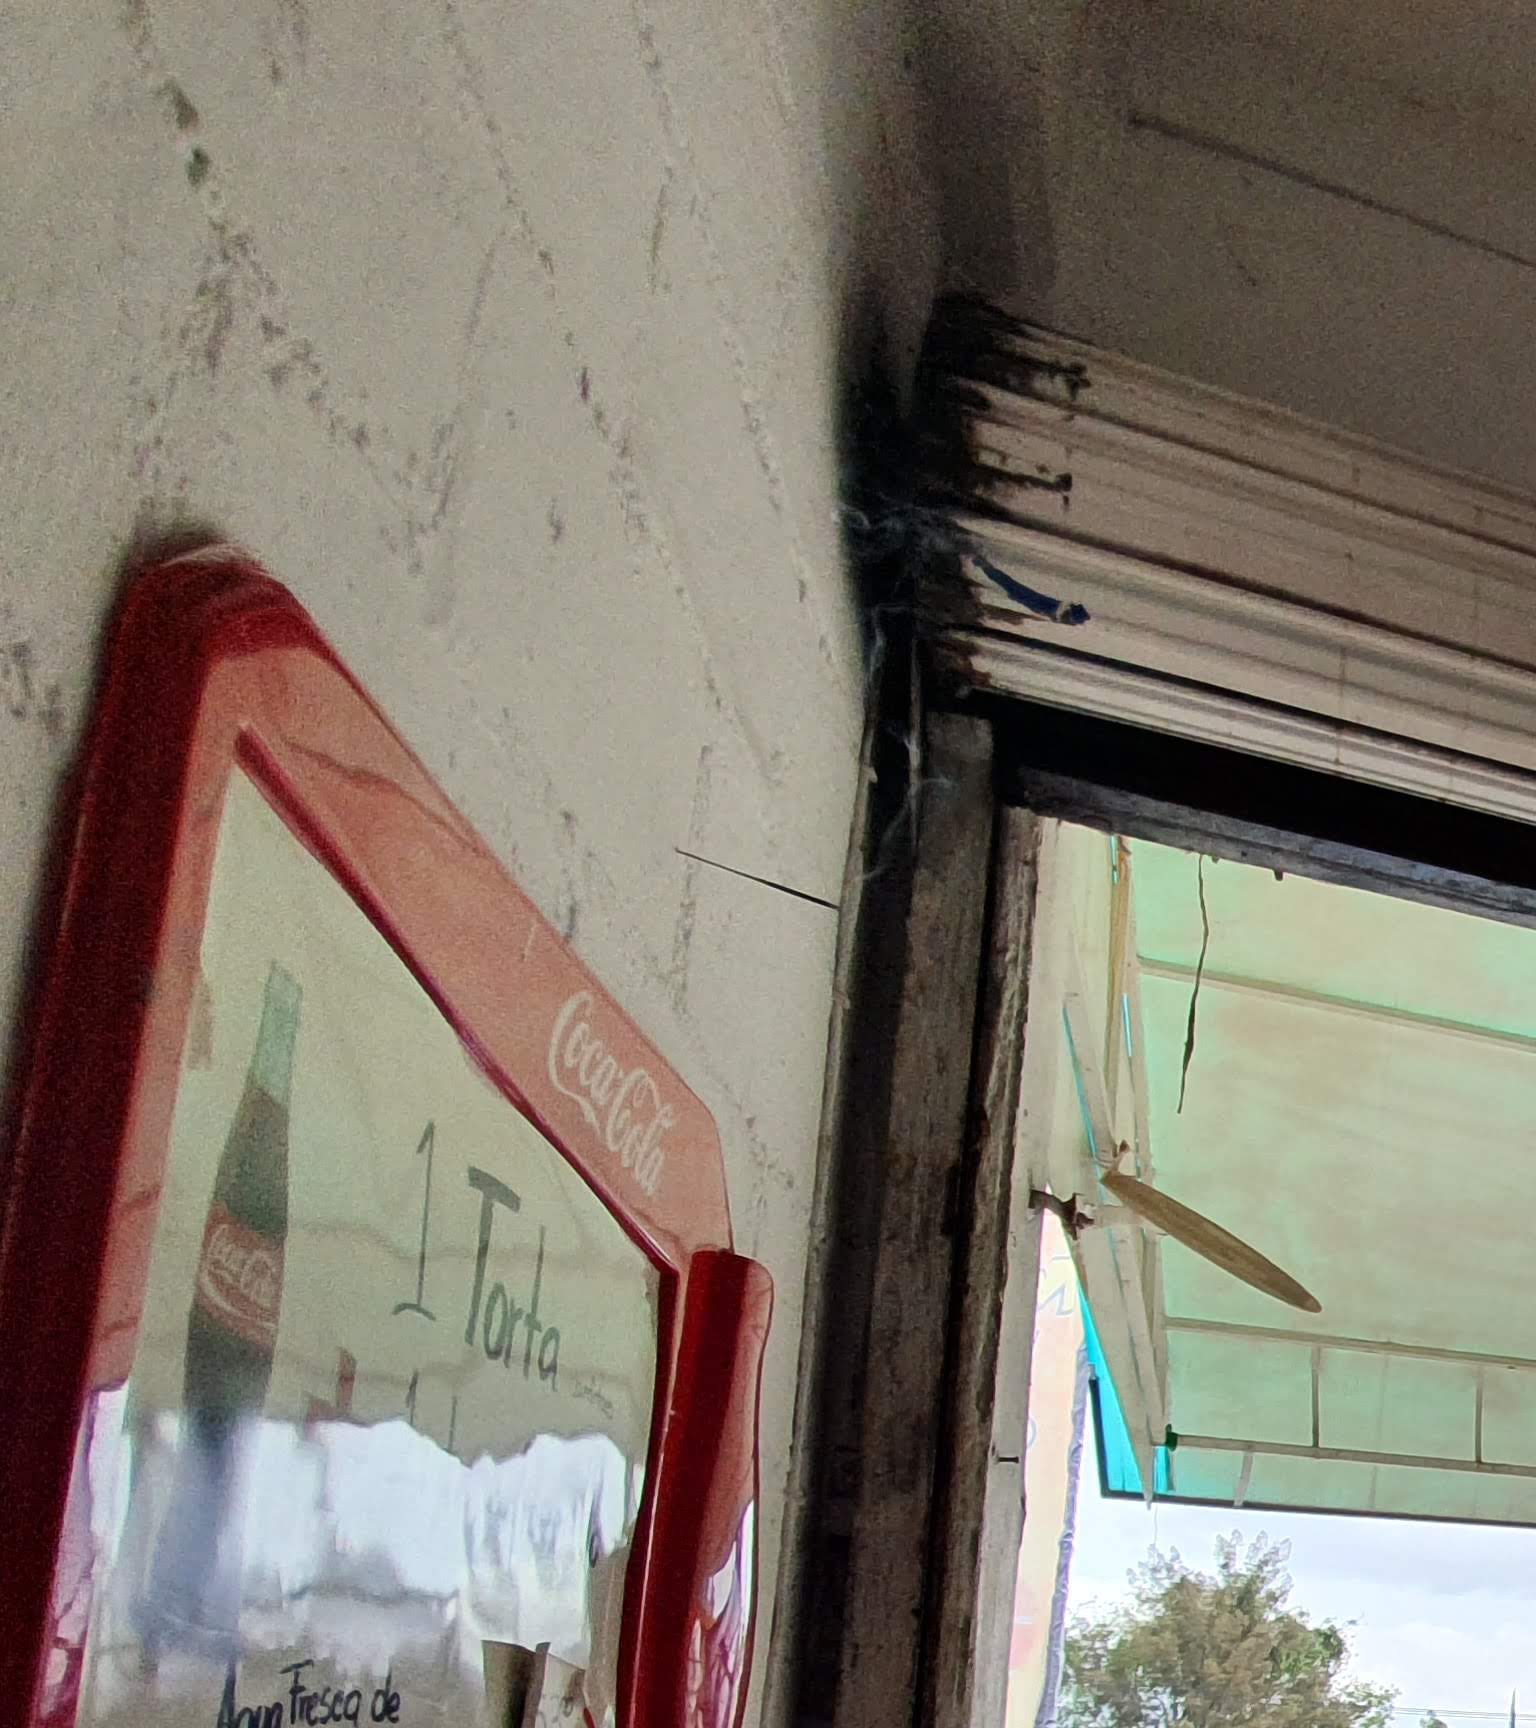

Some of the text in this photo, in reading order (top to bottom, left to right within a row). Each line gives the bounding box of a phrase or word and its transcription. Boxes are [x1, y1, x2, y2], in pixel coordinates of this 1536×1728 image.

[549, 991, 672, 1198] Coca-Cola
[393, 1121, 561, 1392] 1 Torta
[281, 1660, 362, 1728] Fresca
[370, 1676, 400, 1724] de
